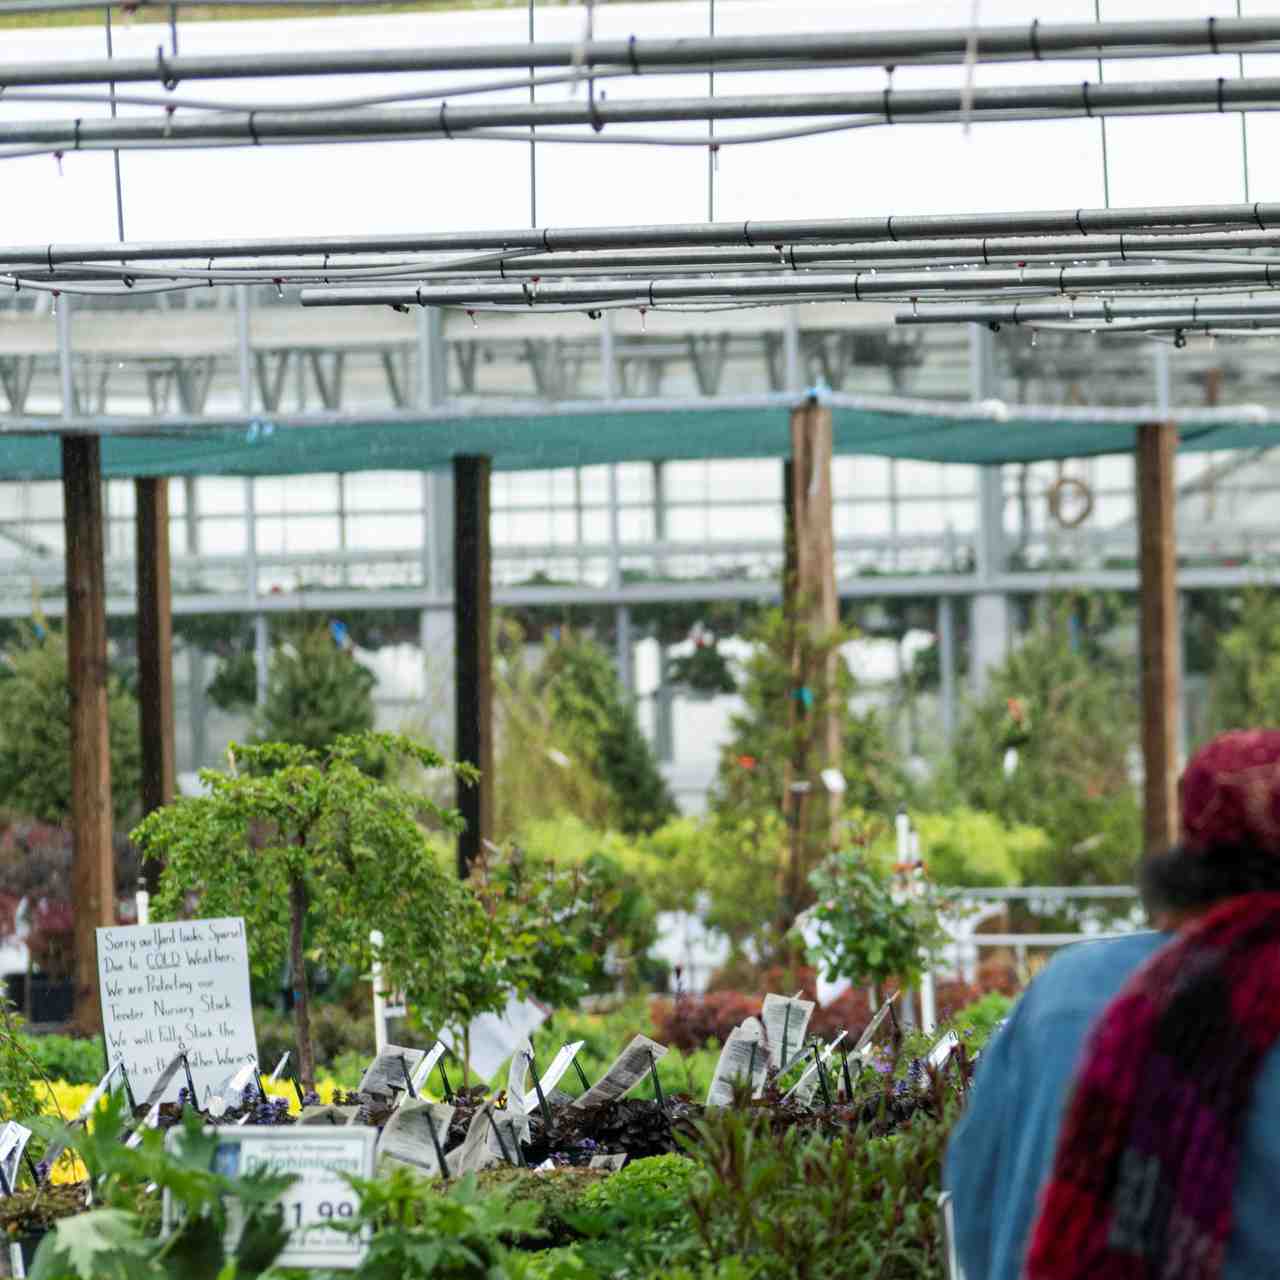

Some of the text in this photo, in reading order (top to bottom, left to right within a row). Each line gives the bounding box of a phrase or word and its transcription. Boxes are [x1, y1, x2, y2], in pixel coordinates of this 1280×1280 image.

[104, 931, 136, 954] Sorry
[178, 926, 203, 942] looks
[103, 957, 123, 974] Due
[128, 958, 139, 970] to
[145, 951, 181, 970] COLD
[105, 980, 123, 998] We
[127, 985, 143, 995] are
[145, 972, 192, 994] Protecting
[109, 993, 232, 1023] Tender Nursery Stock
[108, 1030, 127, 1049] We
[134, 1028, 154, 1046] will
[185, 1022, 213, 1041] Stock
[218, 1020, 235, 1038] the
